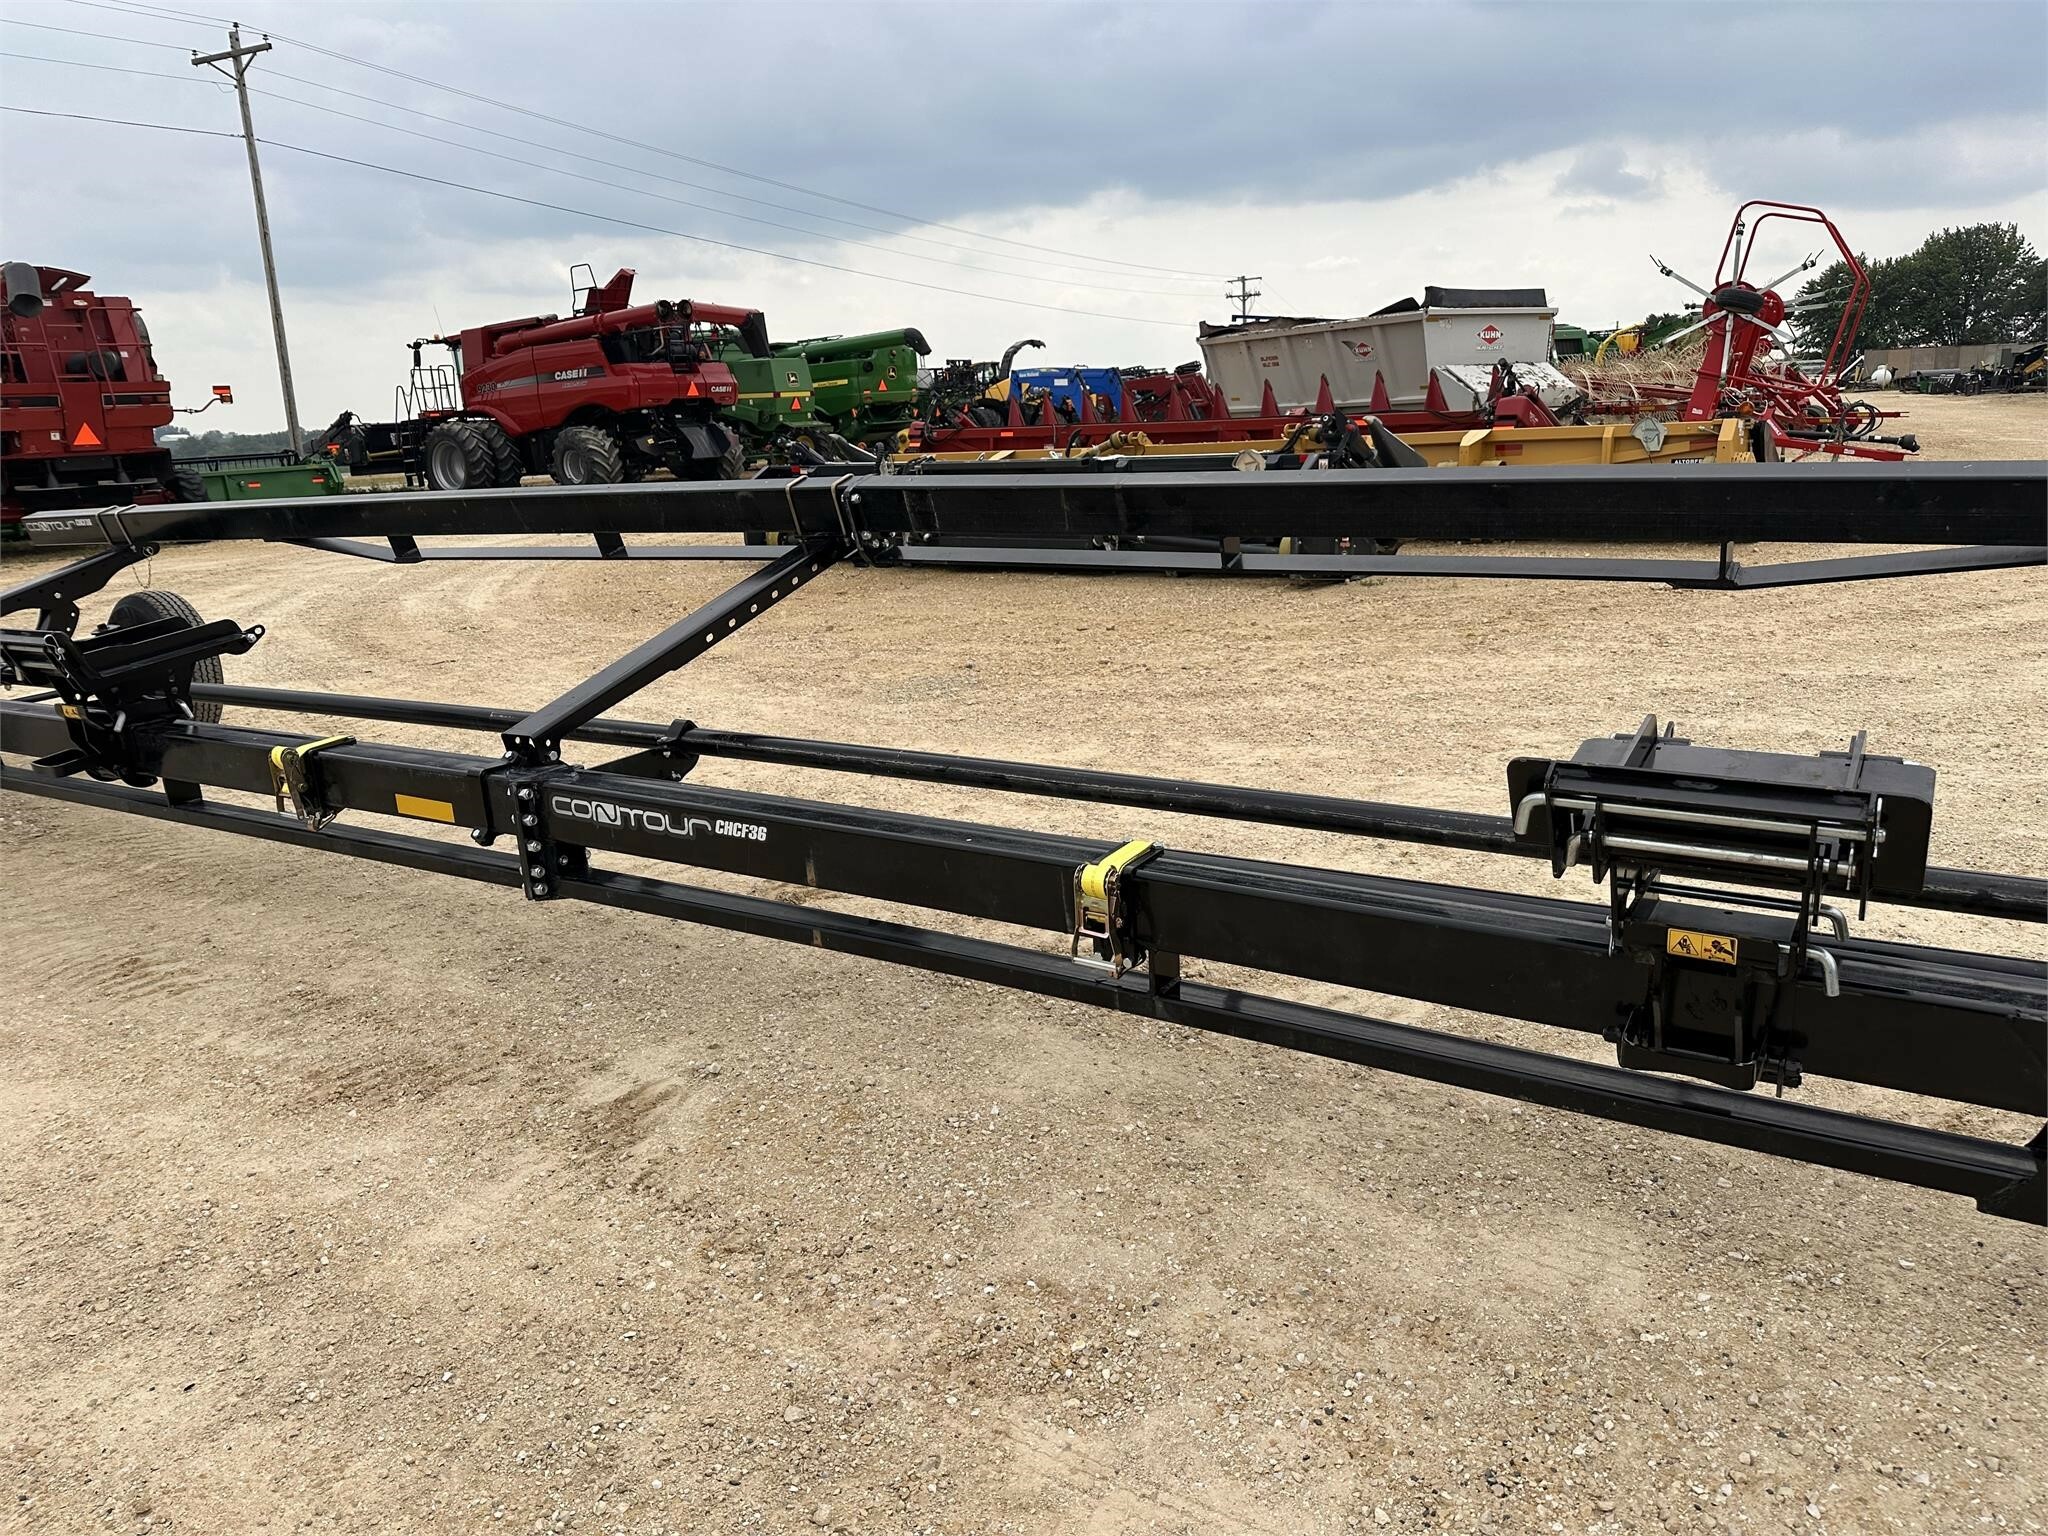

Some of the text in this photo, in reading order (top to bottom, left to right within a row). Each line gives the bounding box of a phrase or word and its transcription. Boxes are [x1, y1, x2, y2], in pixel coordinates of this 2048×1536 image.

[1480, 330, 1501, 339] KUHN
[554, 369, 579, 381] CASE
[26, 521, 75, 531] CONTOUR
[552, 796, 768, 842] CONTOUR CHCF36
